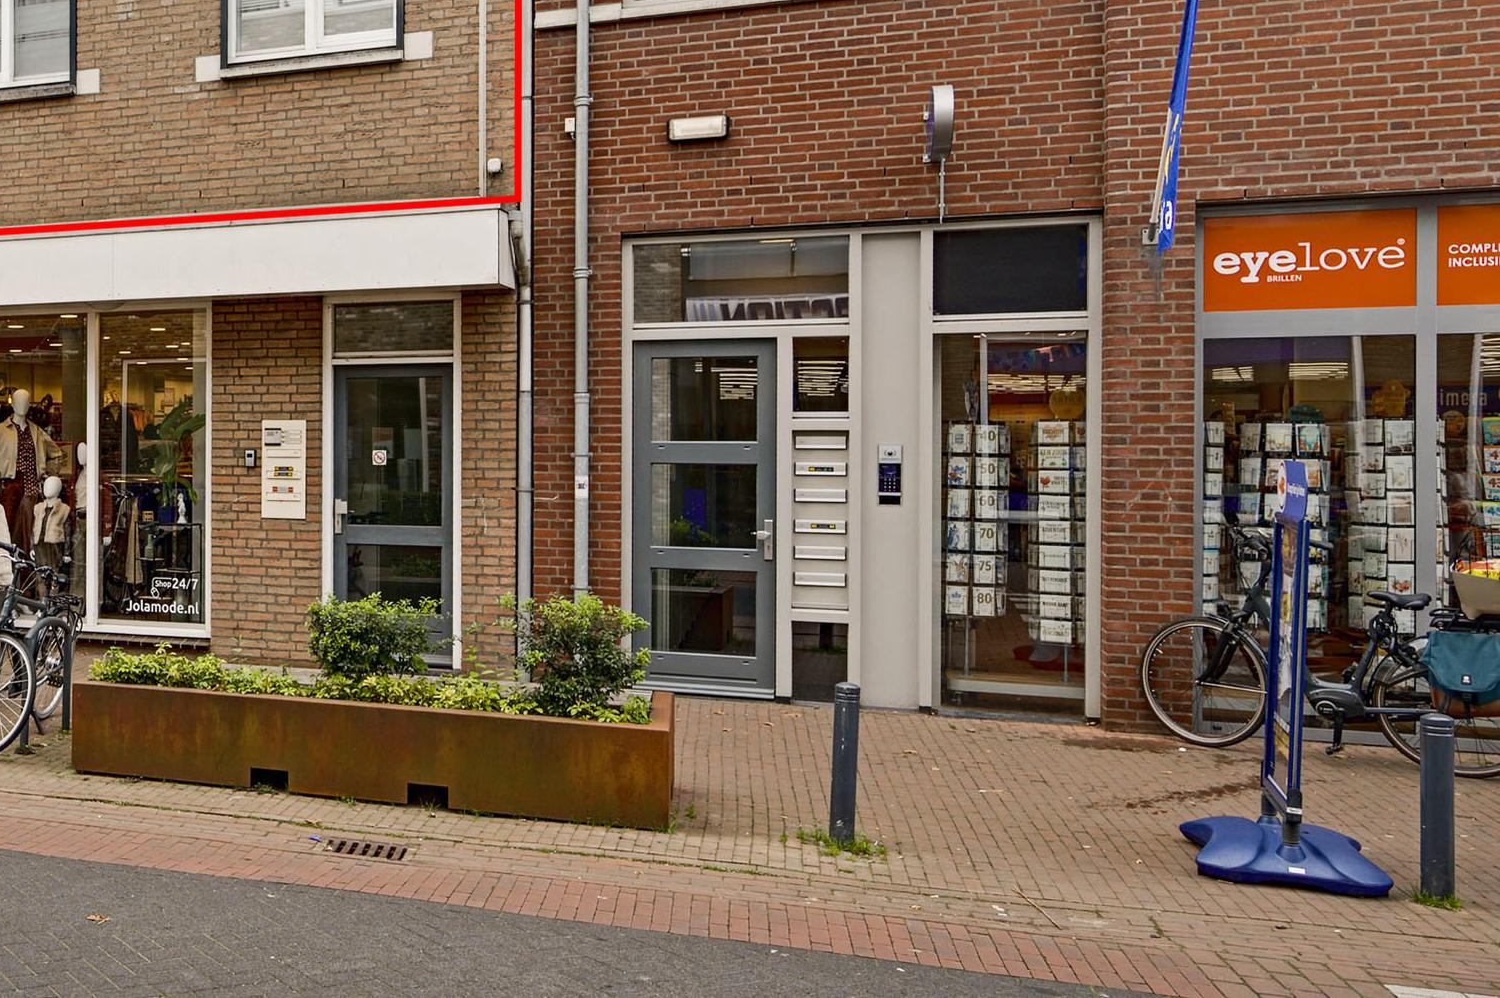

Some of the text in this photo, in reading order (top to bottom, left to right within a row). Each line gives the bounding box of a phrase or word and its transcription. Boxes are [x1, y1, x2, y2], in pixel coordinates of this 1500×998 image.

[1448, 256, 1500, 267] INCLUSI
[1266, 274, 1302, 283] BRILLEN
[980, 463, 996, 474] 50
[979, 495, 995, 506] 60
[980, 527, 994, 539] 70
[980, 560, 992, 571] 75
[154, 577, 199, 590] Shop 24/7
[977, 593, 992, 603] 80
[126, 599, 200, 614] Jolamode.nl
